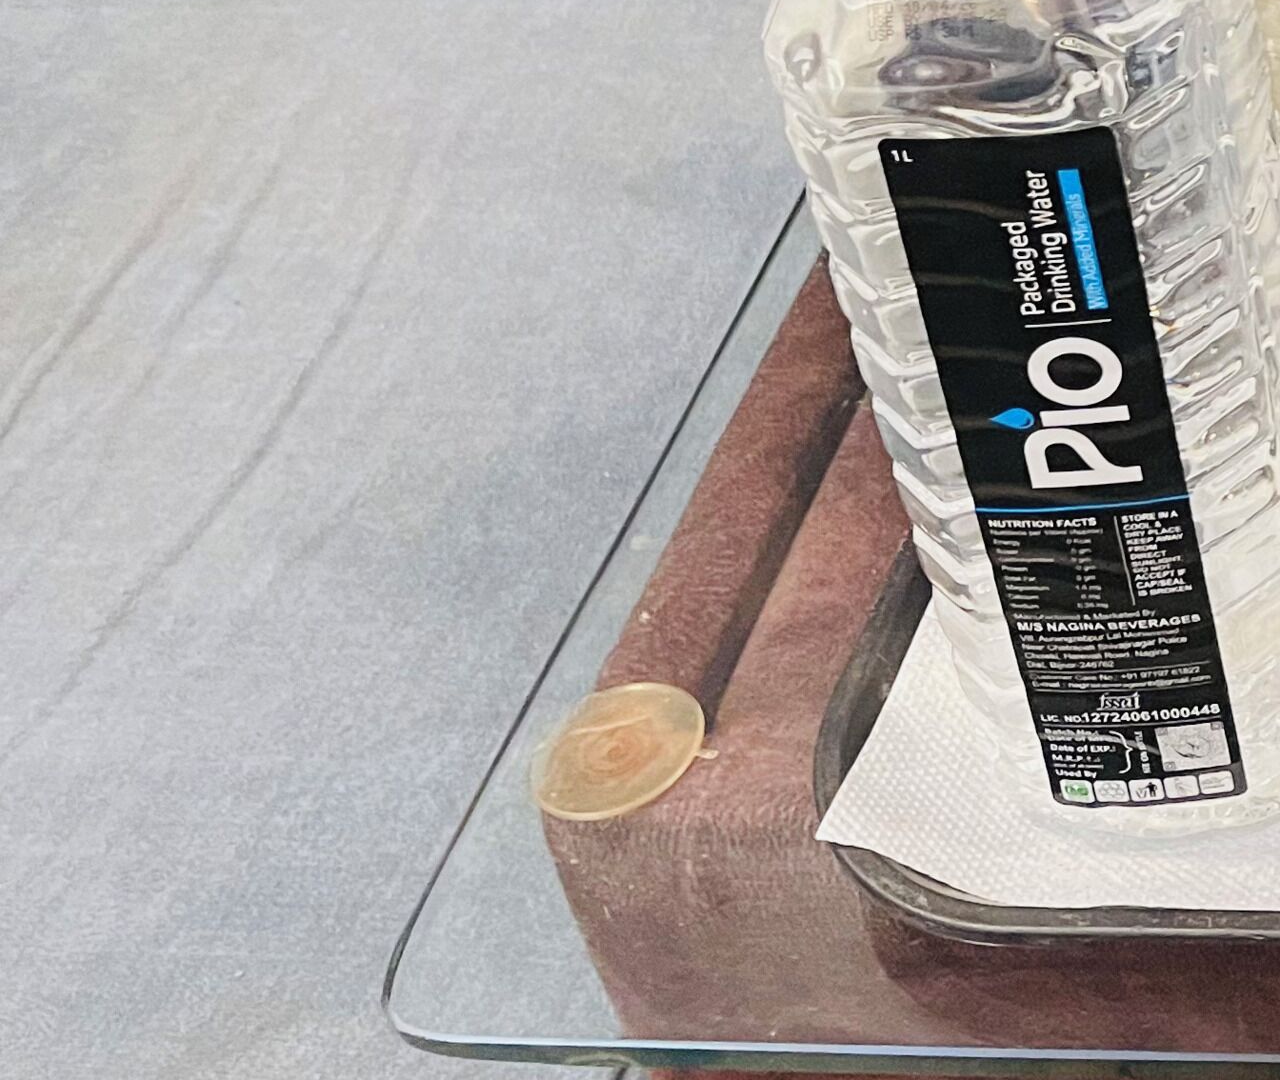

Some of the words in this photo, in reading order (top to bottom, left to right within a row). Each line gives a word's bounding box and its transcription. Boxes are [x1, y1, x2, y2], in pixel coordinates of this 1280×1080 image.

[1026, 169, 1058, 229] Water
[1065, 193, 1091, 242] Minerals
[1001, 220, 1045, 316] Packaged
[1074, 245, 1097, 281] Added
[1040, 231, 1077, 313] Drinking
[1084, 281, 1108, 311] With
[988, 519, 1053, 529] NUTRITION
[1056, 517, 1097, 527] FACTS
[1120, 513, 1156, 524] STORE
[1169, 510, 1179, 519] A
[1123, 522, 1152, 531] COOL
[1147, 525, 1182, 537] PLACE
[1126, 537, 1154, 546] KEEP
[1127, 543, 1158, 553] FROM
[1130, 550, 1167, 561] DIRECT
[1135, 569, 1177, 581] ACCEPT
[1149, 584, 1193, 596] BROKEN
[1016, 622, 1043, 632] M/S
[1046, 621, 1105, 632] NAGINA
[1107, 614, 1201, 631] BEVERAGES
[1096, 691, 1141, 711] fssai
[1050, 743, 1075, 752] Date
[1076, 744, 1088, 753] of
[1055, 769, 1082, 778] Used
[1083, 770, 1098, 779] By
